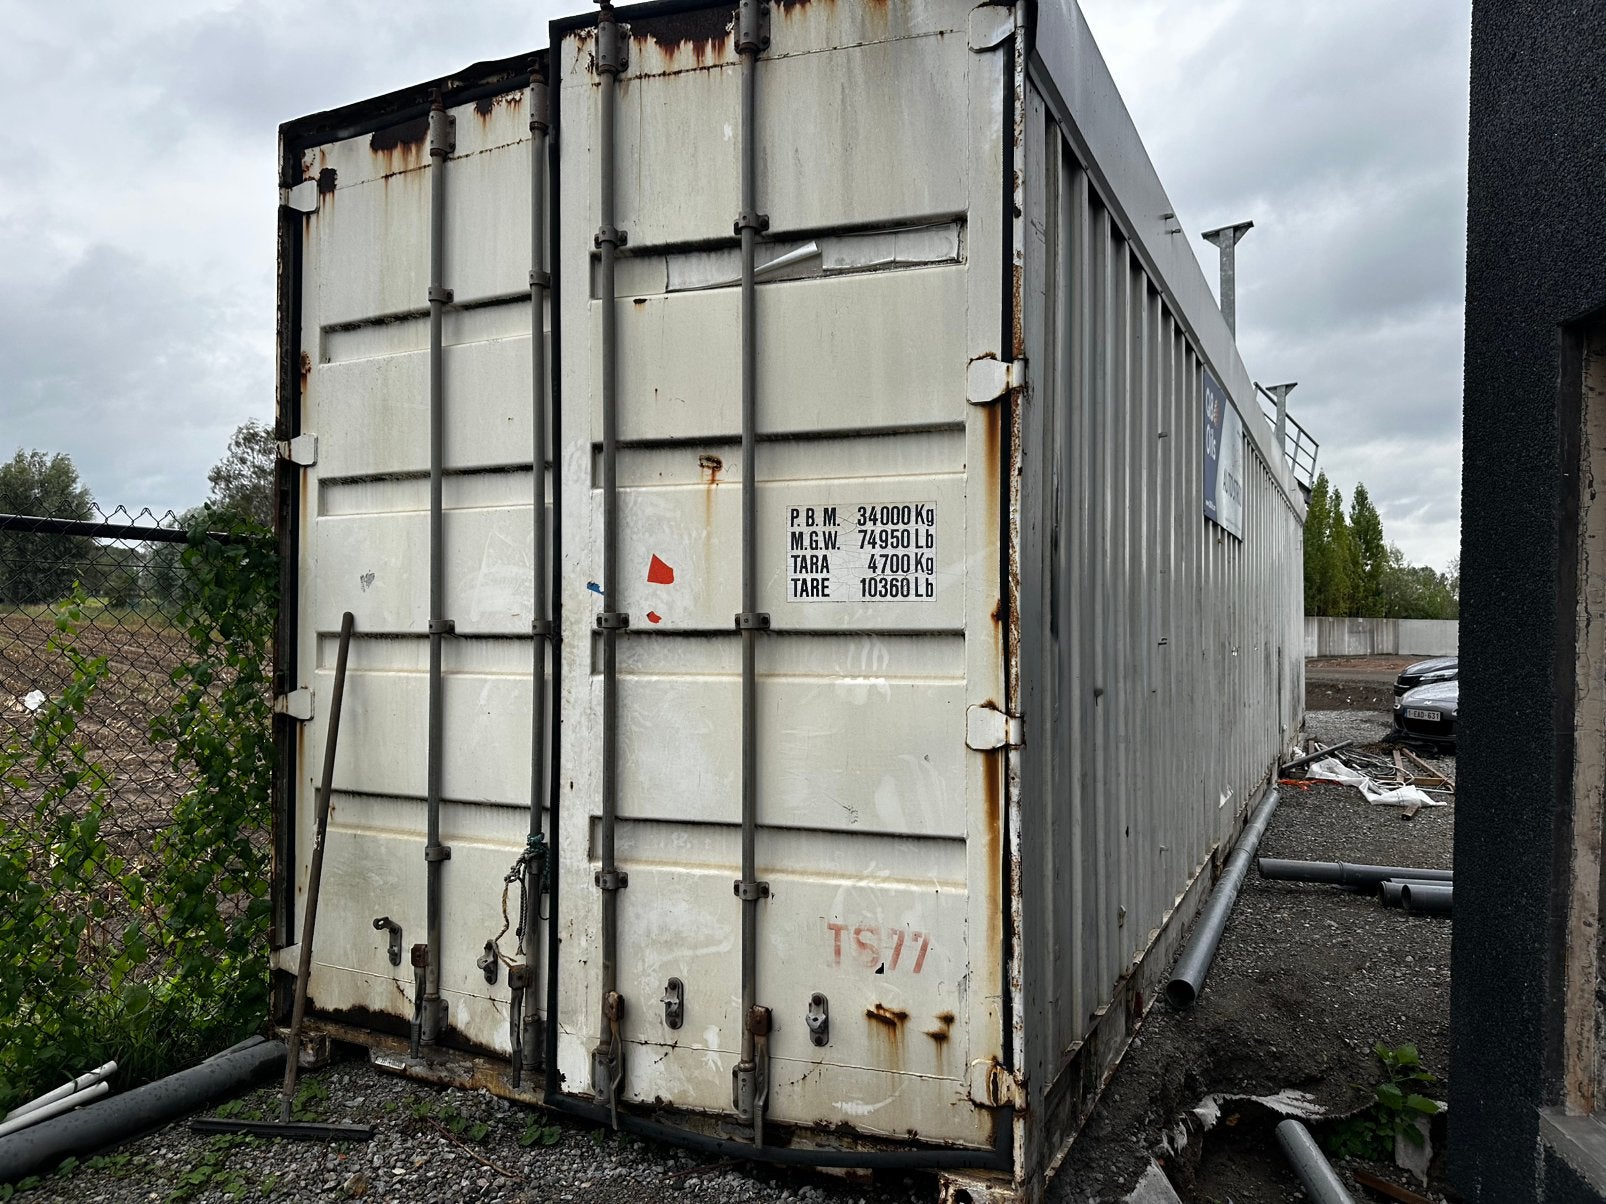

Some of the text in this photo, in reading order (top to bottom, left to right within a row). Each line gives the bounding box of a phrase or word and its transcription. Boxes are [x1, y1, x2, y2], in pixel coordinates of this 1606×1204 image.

[857, 505, 912, 526] 34000
[914, 504, 934, 527] Kg
[790, 528, 934, 550] M.G.W. 74950 Lb
[790, 552, 934, 576] TARA 4700 Kg
[790, 576, 934, 597] TARE 10360 Lb
[827, 922, 930, 973] TS77
